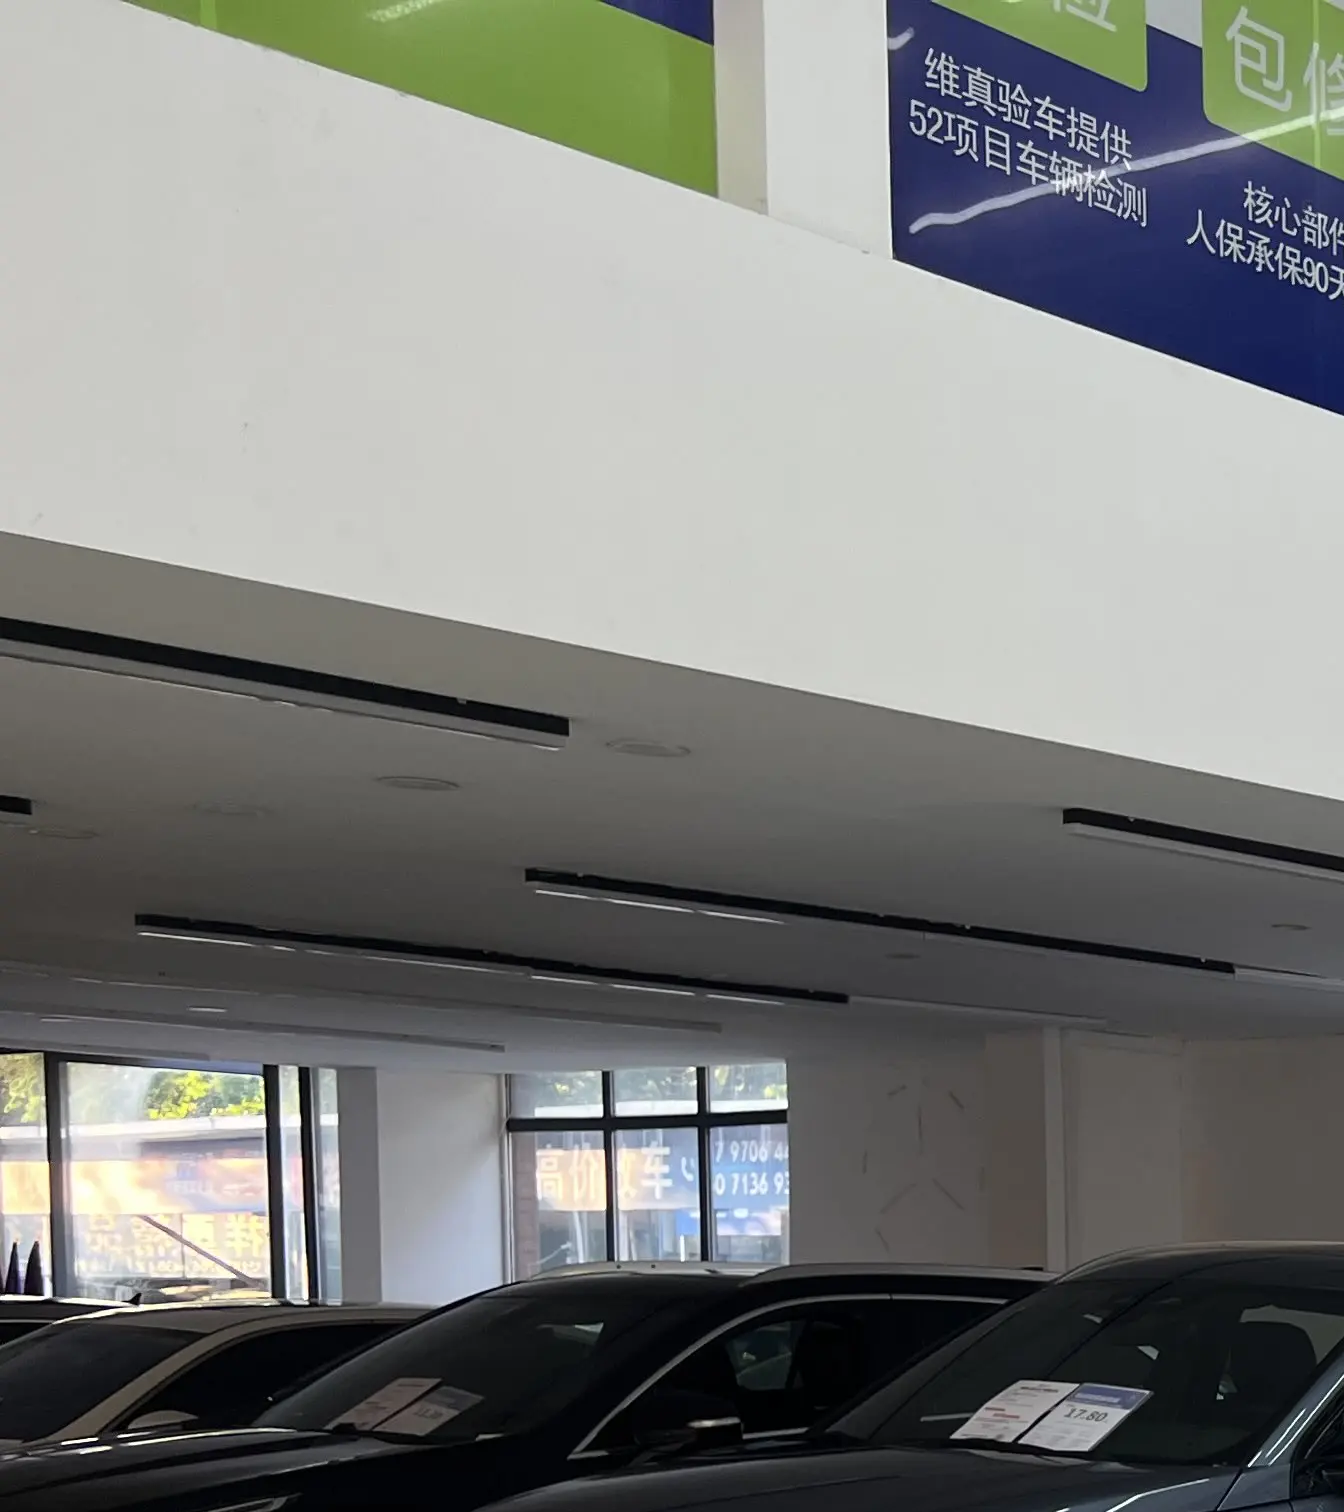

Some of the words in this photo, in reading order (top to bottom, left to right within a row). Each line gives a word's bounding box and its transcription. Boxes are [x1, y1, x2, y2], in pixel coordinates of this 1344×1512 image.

[909, 98, 1148, 228] 52项目车辆检测
[923, 47, 1133, 171] 维真验车提供
[731, 1172, 768, 1196] 7136
